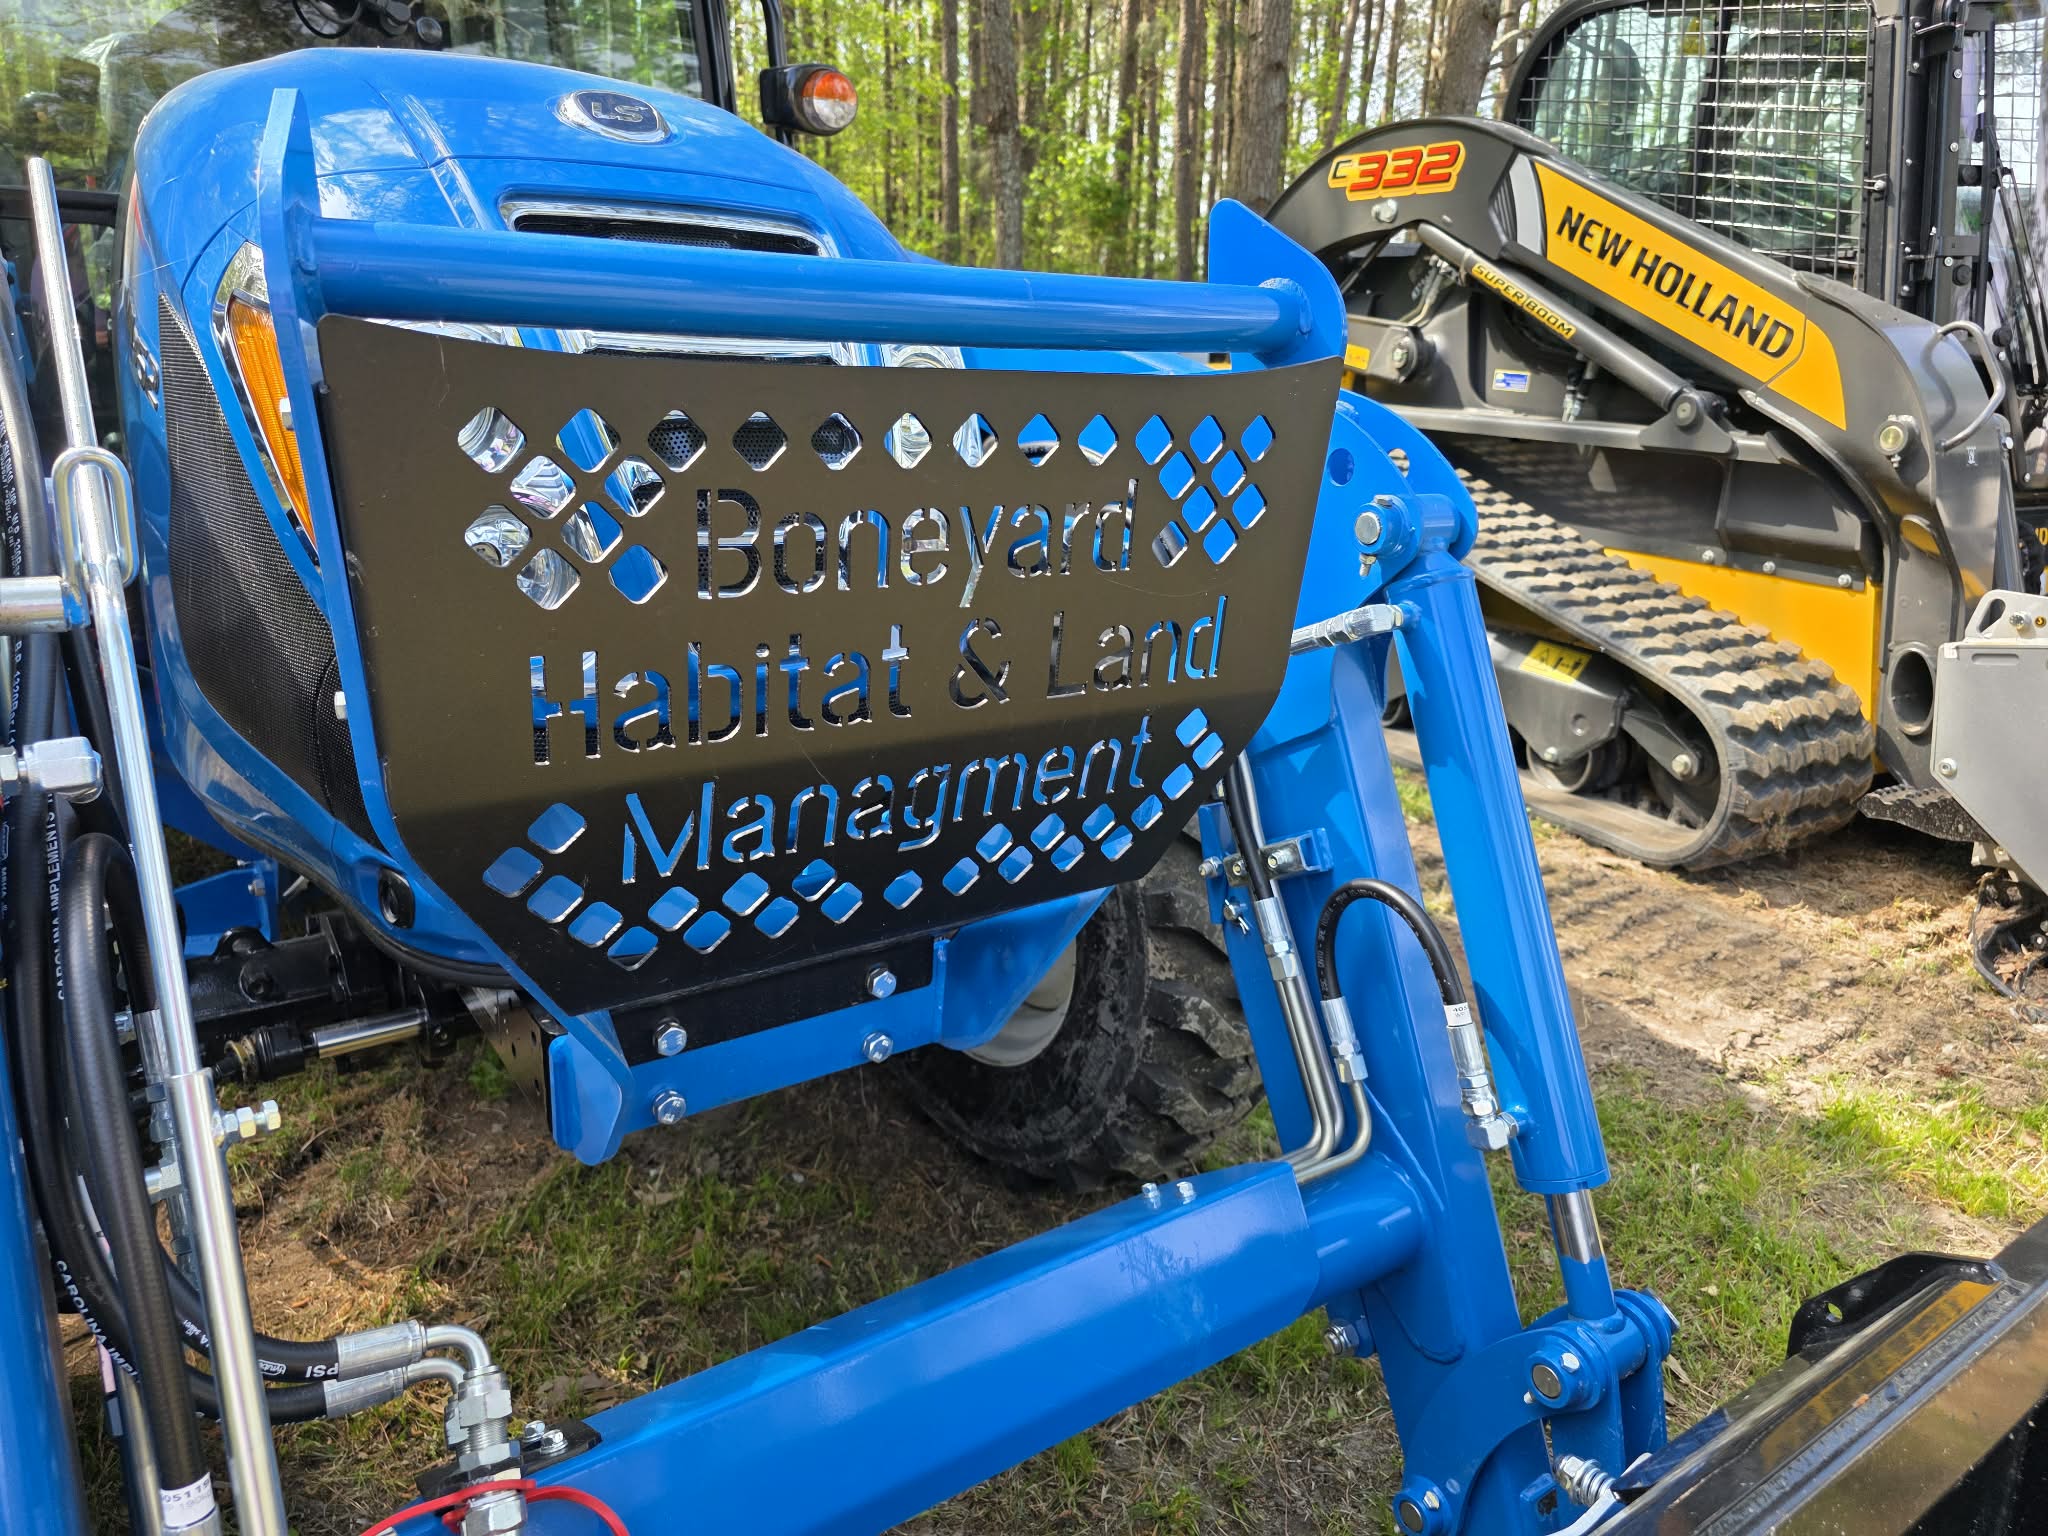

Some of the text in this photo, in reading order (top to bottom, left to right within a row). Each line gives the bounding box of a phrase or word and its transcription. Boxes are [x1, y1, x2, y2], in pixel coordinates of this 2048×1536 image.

[591, 101, 648, 123] LS
[1331, 143, 1461, 192] C332
[1556, 205, 1795, 359] NEW HOLLAND
[695, 478, 1140, 608] Boneyard
[529, 594, 1229, 766] Habitat & Land
[622, 715, 1154, 884] Managment
[56, 1260, 107, 1345] CAROLINA
[305, 1361, 338, 1379] PSI
